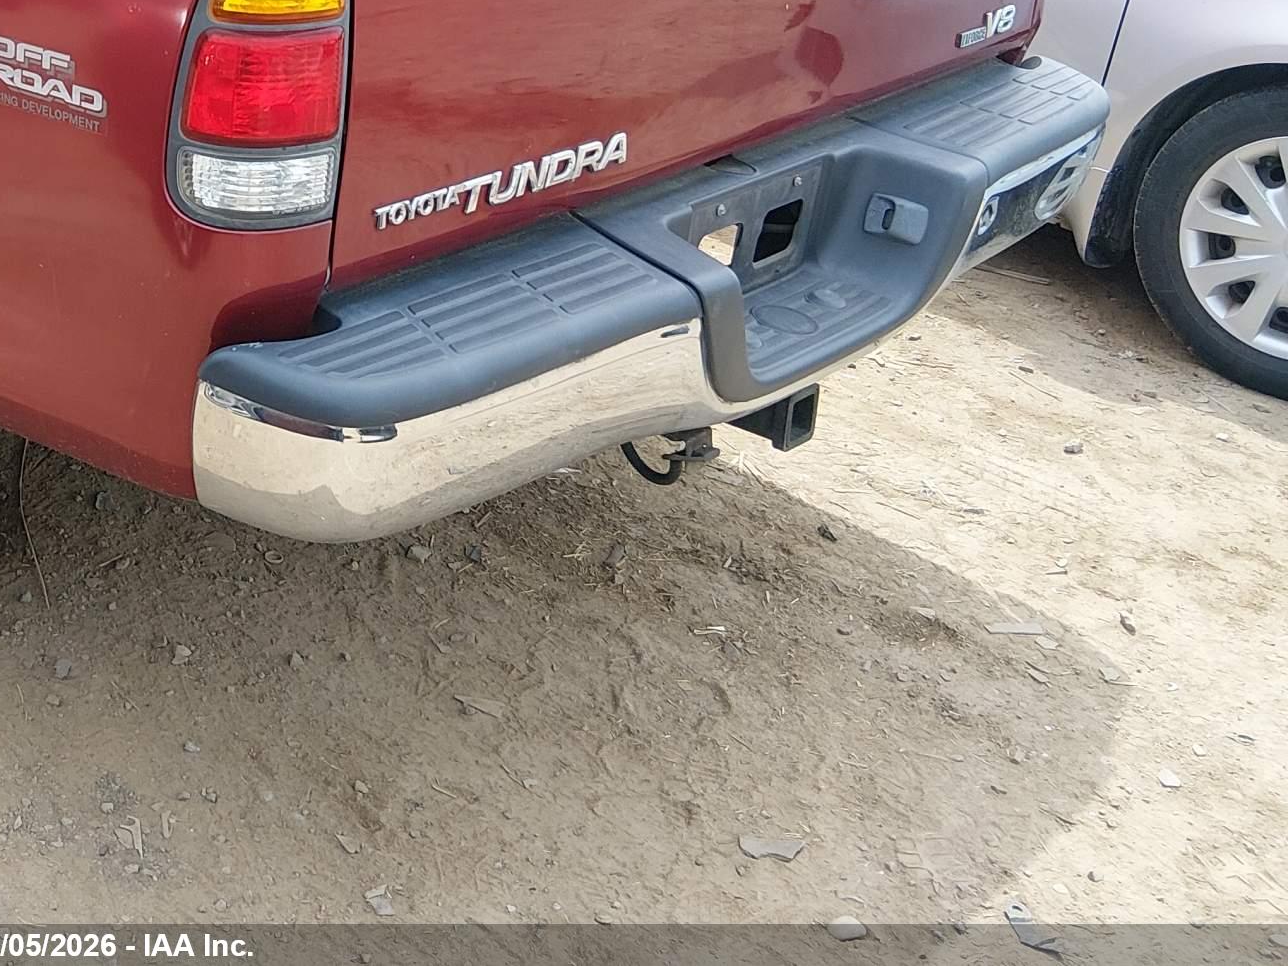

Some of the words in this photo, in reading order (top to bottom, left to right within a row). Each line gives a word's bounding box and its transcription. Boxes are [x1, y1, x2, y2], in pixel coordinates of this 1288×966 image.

[984, 4, 1016, 39] V8
[21, 99, 101, 133] DEVELOPMENT
[374, 187, 461, 231] TOYOTA
[459, 132, 628, 215] TUNDRA
